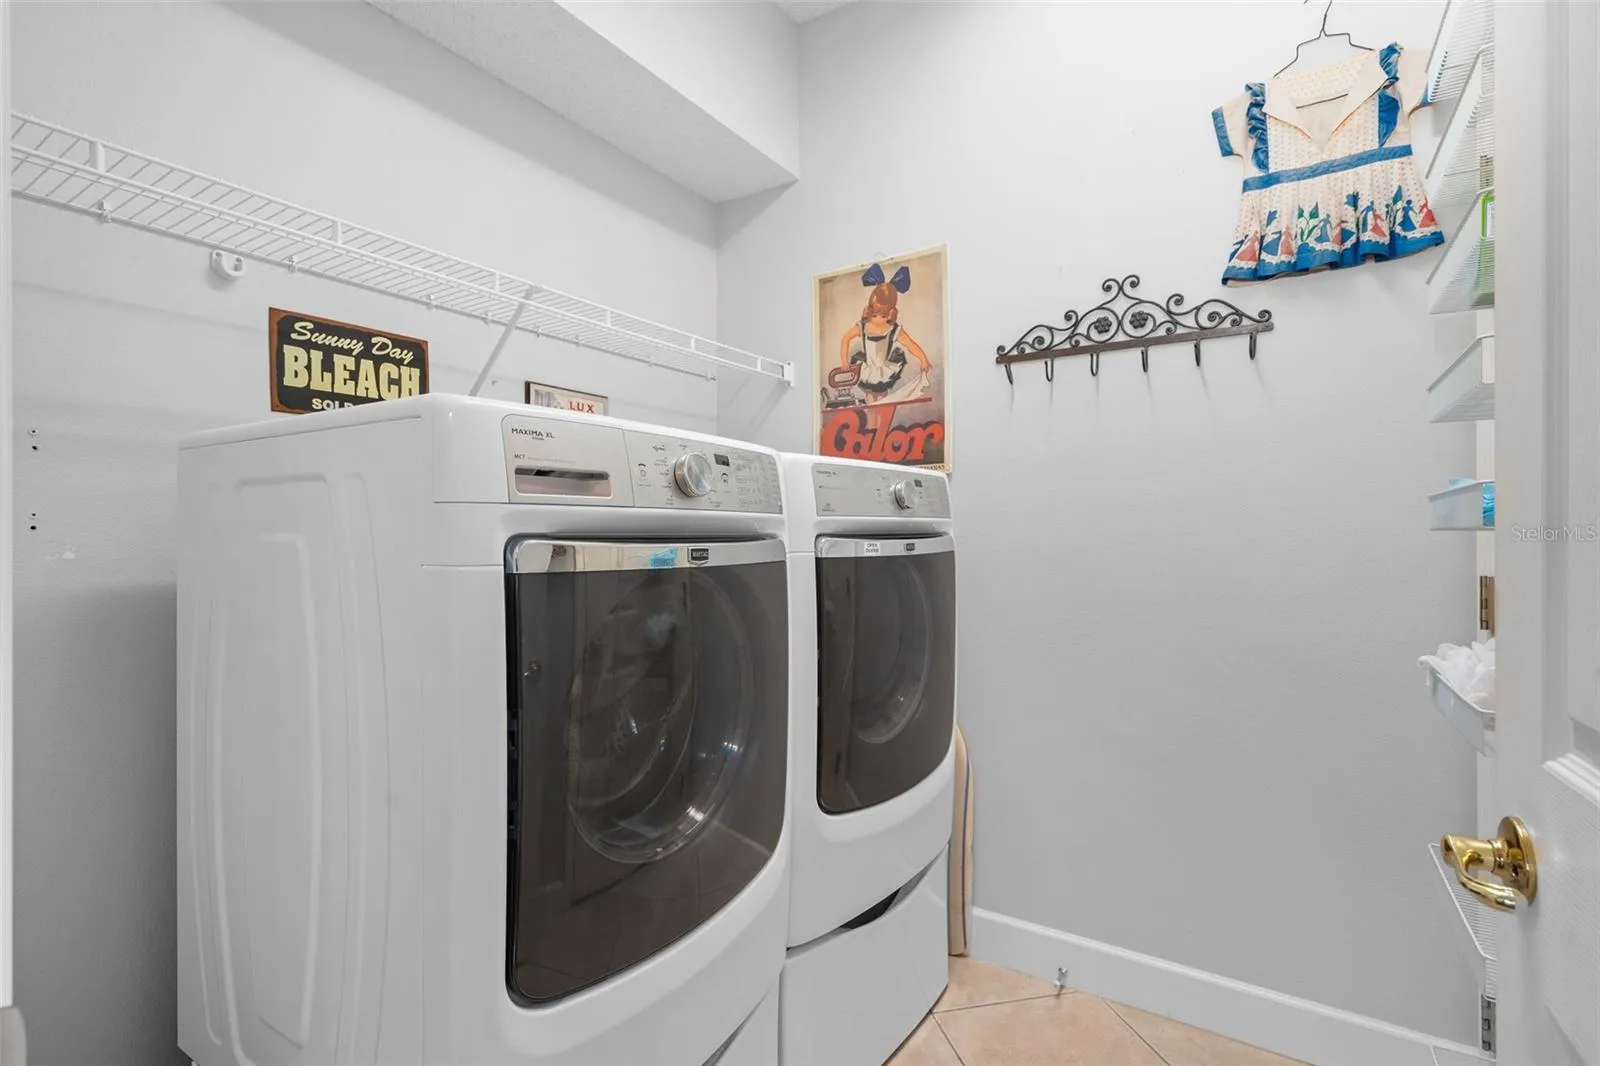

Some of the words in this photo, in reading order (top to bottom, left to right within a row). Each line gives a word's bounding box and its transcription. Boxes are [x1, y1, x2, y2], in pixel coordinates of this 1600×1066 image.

[290, 321, 364, 355] Sunny
[371, 336, 413, 364] Day
[283, 344, 420, 400] BLEACH
[569, 401, 594, 413] LUX
[511, 428, 543, 437] MAXIMA
[821, 404, 944, 462] Calor
